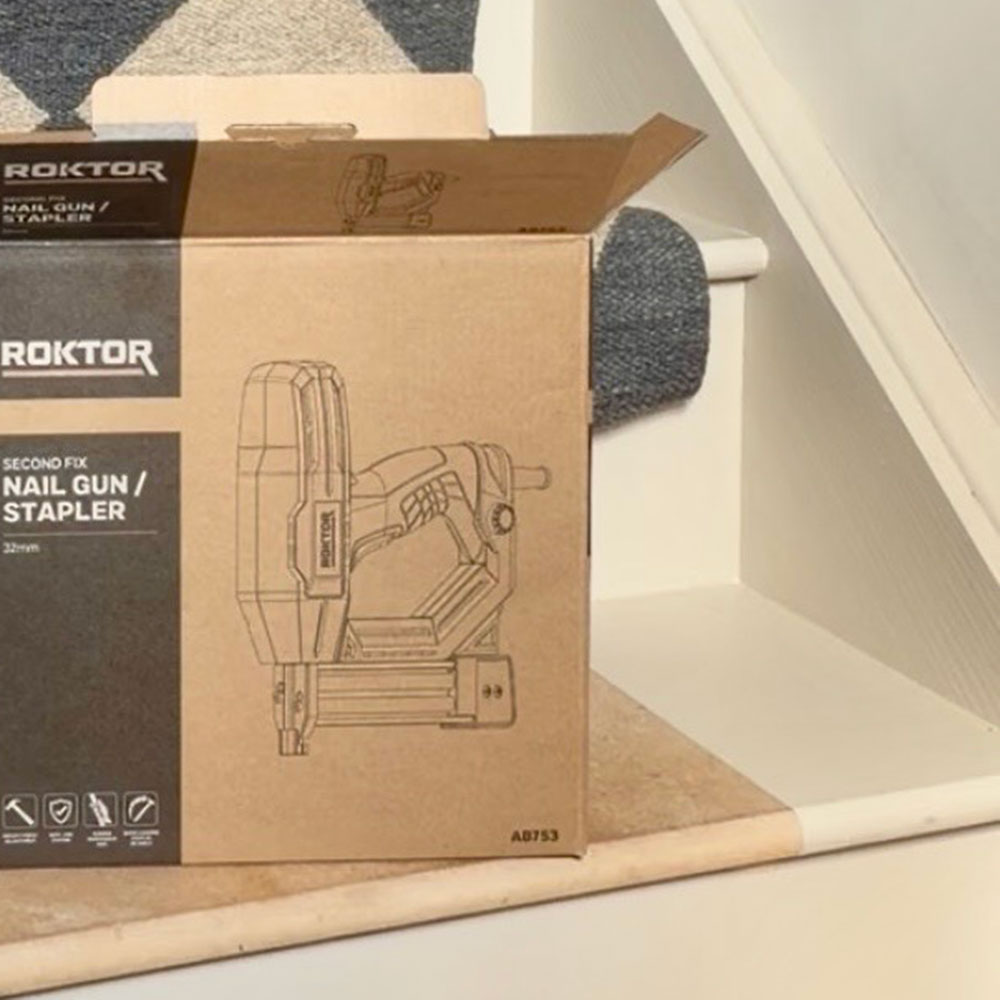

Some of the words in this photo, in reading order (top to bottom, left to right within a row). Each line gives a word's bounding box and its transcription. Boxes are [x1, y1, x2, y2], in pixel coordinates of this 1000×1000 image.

[3, 160, 167, 183] ROKTOR
[3, 203, 49, 213] NAIL
[54, 202, 95, 212] GUN
[3, 213, 93, 224] STAPLER
[1, 339, 159, 376] ROKTOR
[2, 457, 62, 471] SECOND
[64, 455, 88, 469] FIX
[2, 474, 66, 496] NAIL
[72, 473, 129, 495] GUN
[134, 471, 148, 497] /
[2, 500, 126, 523] STAPLER
[319, 509, 335, 568] ROKTOR
